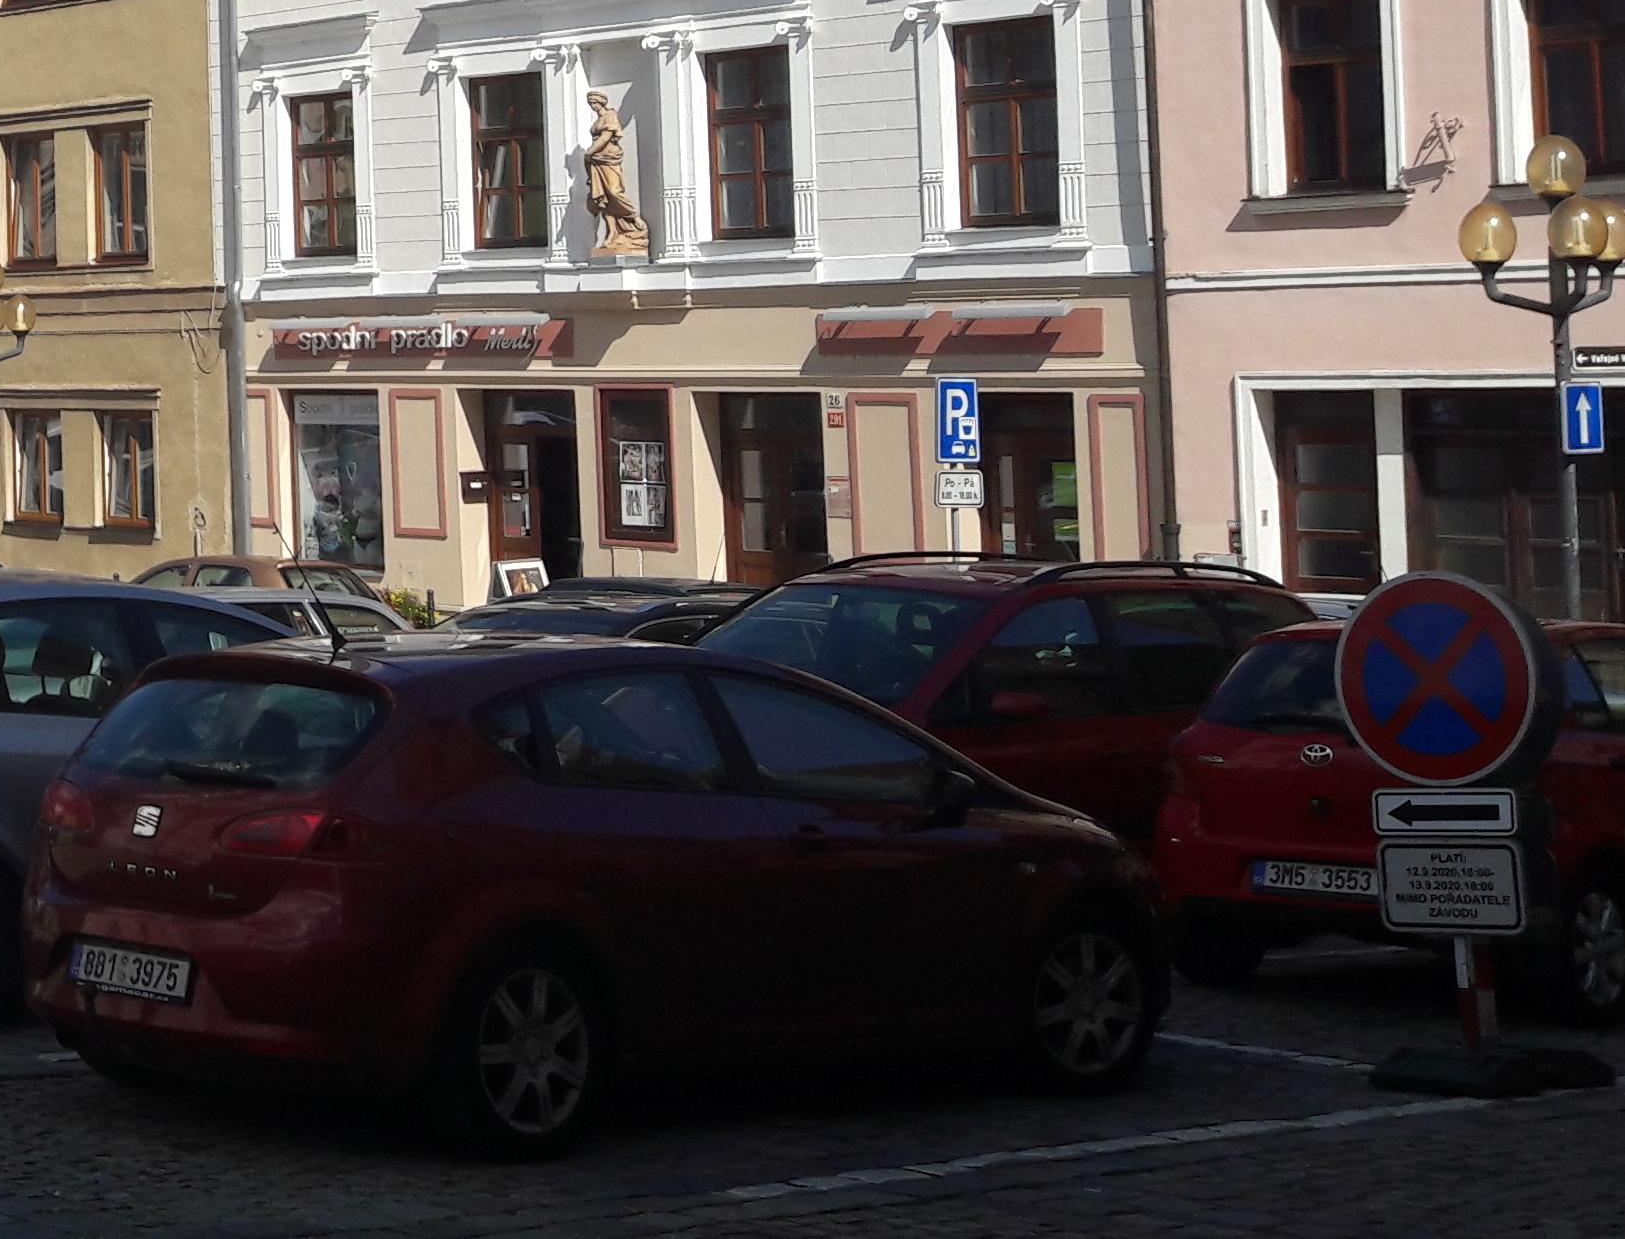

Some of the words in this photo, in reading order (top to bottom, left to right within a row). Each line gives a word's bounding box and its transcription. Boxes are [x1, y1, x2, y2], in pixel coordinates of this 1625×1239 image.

[945, 388, 969, 436] P
[1269, 863, 1306, 886] 3M5
[1321, 868, 1372, 892] 3553
[130, 957, 180, 992] 3975
